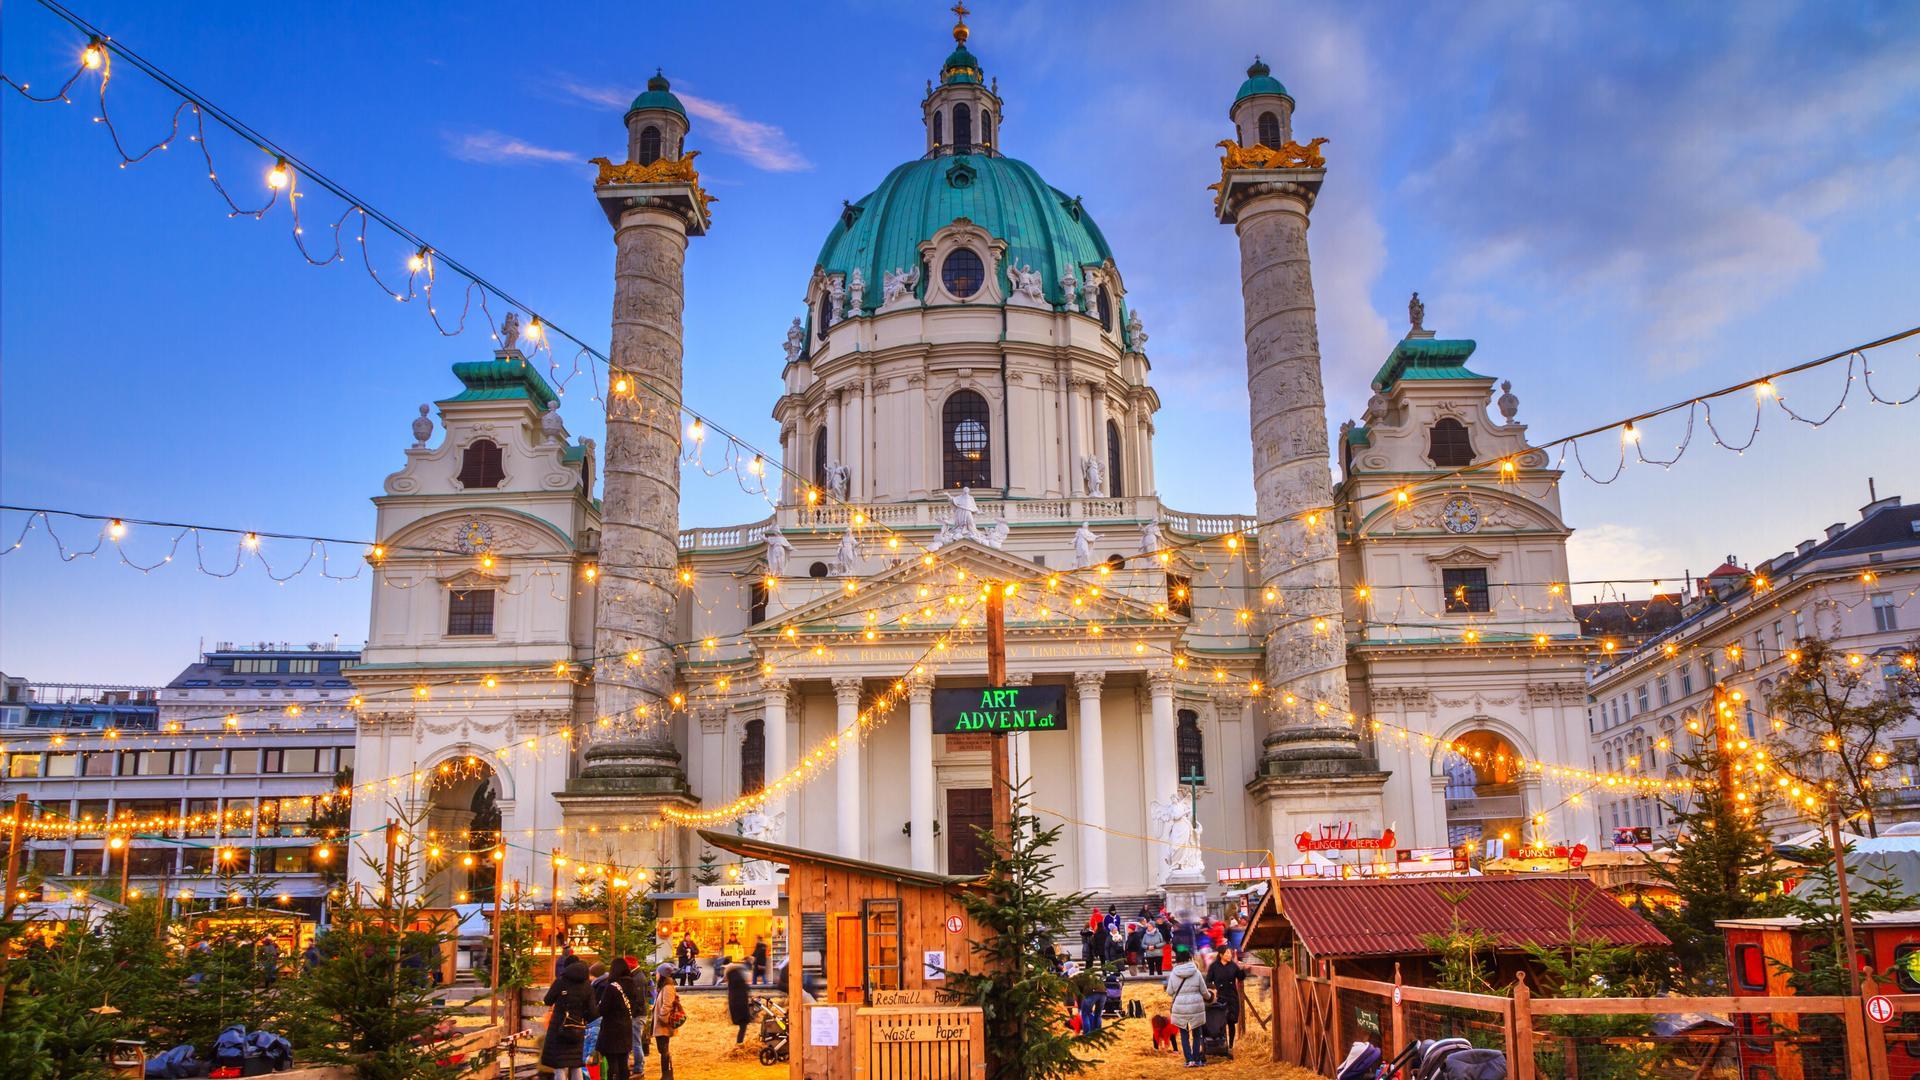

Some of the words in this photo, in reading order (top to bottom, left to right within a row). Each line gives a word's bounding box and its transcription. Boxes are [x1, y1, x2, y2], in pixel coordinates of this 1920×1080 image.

[980, 689, 1018, 709] ART
[955, 709, 1055, 730] ADVENT.at
[1308, 840, 1341, 850] PUNSCH
[1519, 848, 1556, 858] PUNSCH
[720, 887, 757, 899] Karlsplatz
[706, 898, 741, 908] Draisinen
[742, 897, 771, 909] Express
[875, 991, 921, 1006] Restmüll
[881, 1027, 916, 1041] Waste
[935, 1025, 964, 1041] Paper
